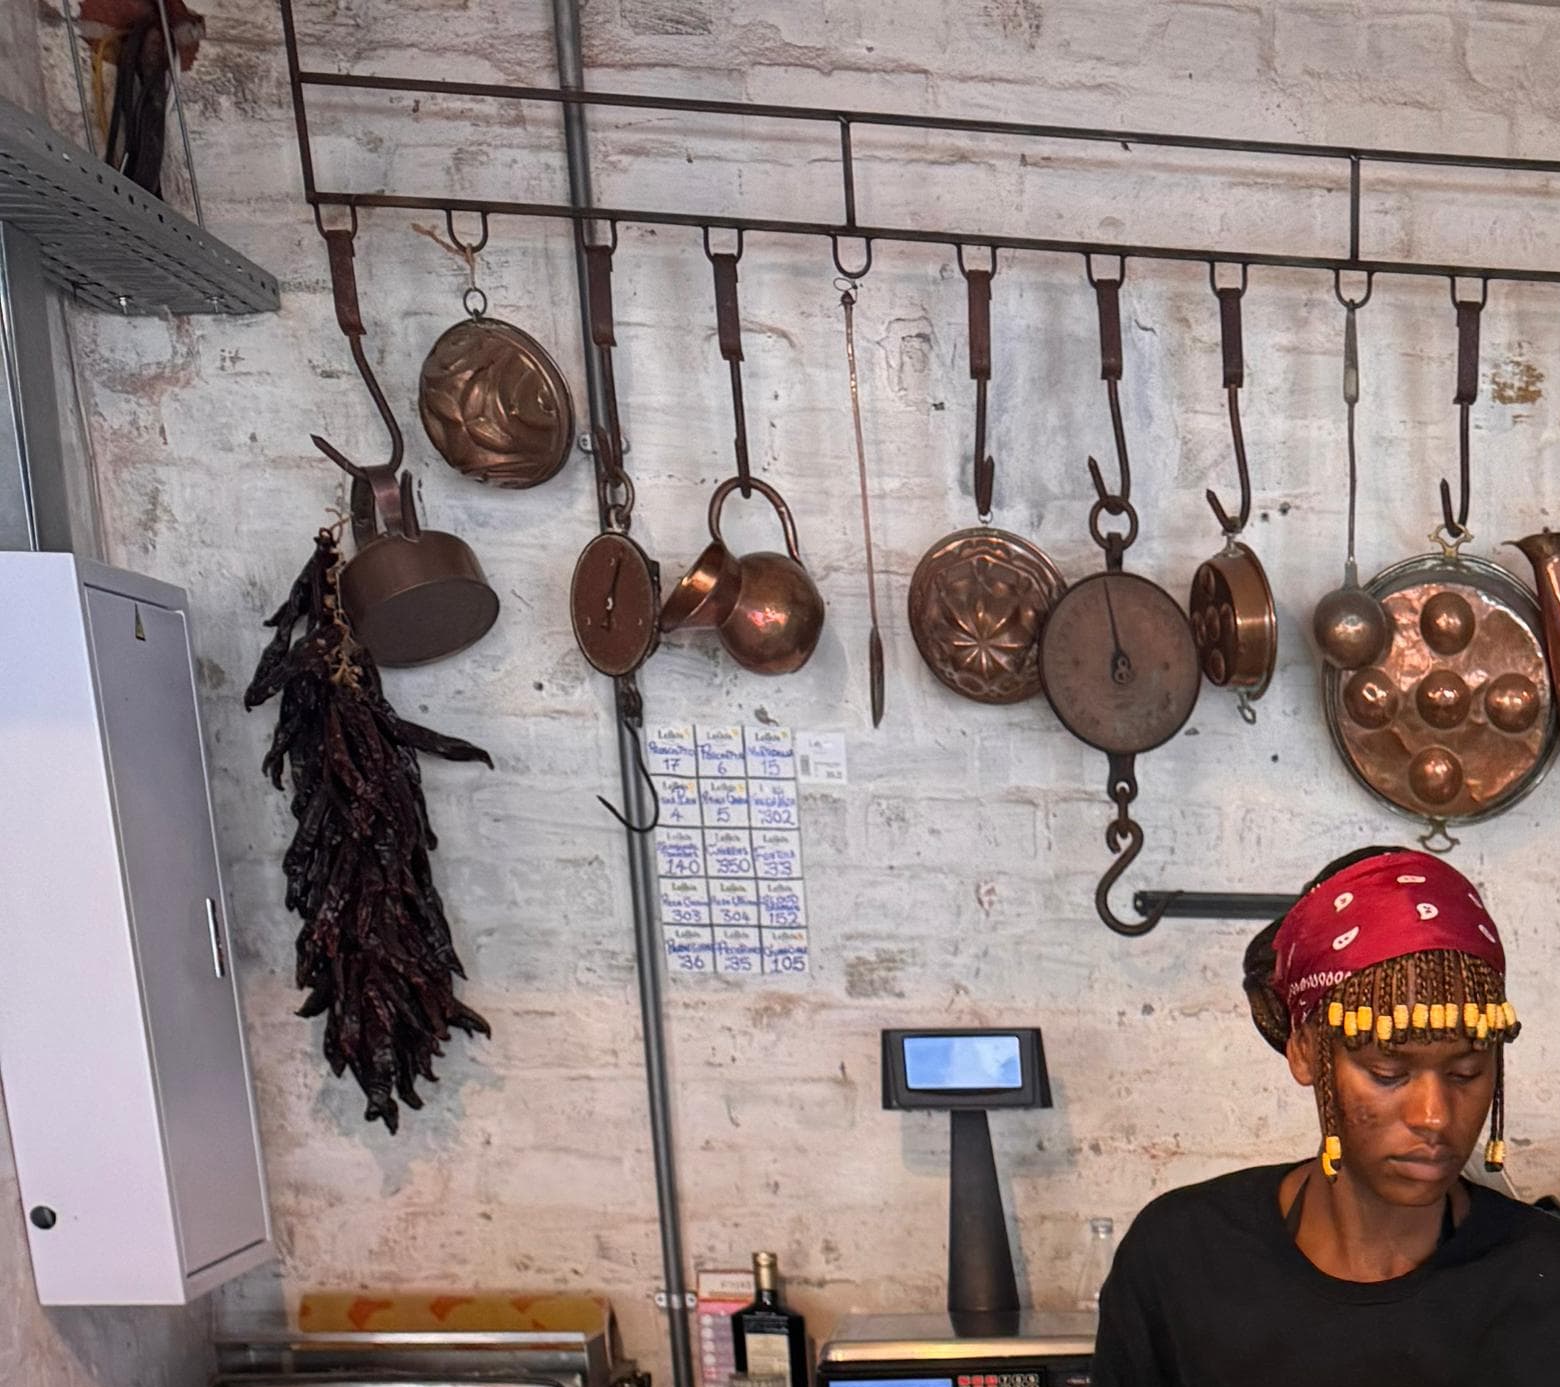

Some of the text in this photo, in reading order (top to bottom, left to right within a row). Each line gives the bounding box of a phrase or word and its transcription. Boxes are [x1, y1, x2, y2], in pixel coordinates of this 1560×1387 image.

[717, 761, 727, 775] 6
[761, 760, 781, 776] 15
[670, 808, 683, 822] 4
[716, 807, 730, 823] 5
